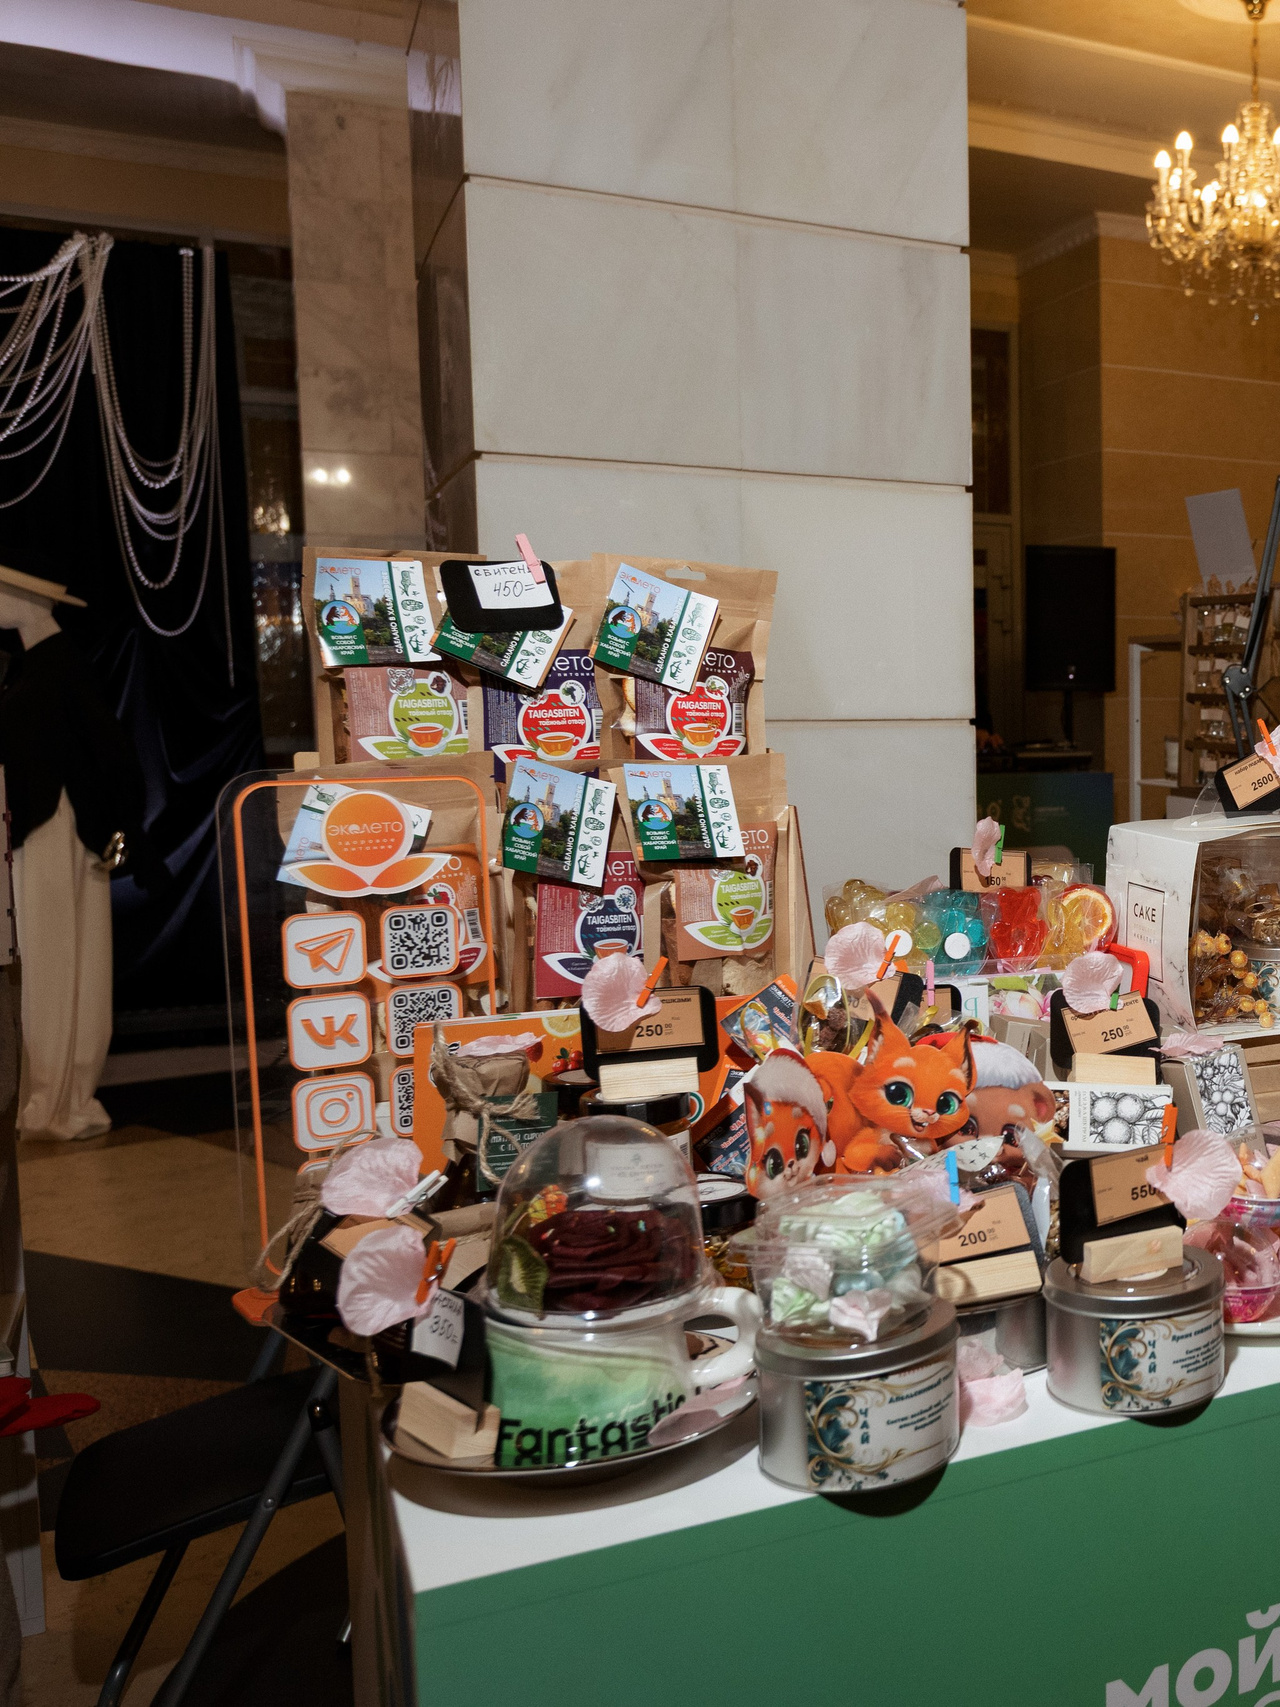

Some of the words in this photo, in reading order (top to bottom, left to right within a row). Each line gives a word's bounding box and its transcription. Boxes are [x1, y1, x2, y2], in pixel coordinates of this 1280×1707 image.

[397, 698, 448, 709] TAIGASBITEN
[677, 701, 722, 710] TAIGASBITEN
[528, 708, 580, 719] TAIGASBITEN
[1251, 773, 1274, 791] 2500
[328, 821, 403, 836] ЭКОЛЕТО
[720, 883, 759, 894] TAIGASBITEN
[985, 876, 1001, 886] 150
[586, 914, 632, 925] TAIGASBITEN
[1133, 903, 1156, 923] CAKE
[635, 1023, 663, 1038] 250
[1101, 1027, 1124, 1042] 250
[1136, 1154, 1150, 1163] чай
[958, 1229, 987, 1247] 200
[1148, 1340, 1157, 1374] ЧАЙ
[859, 1408, 870, 1445] ЧАЙ
